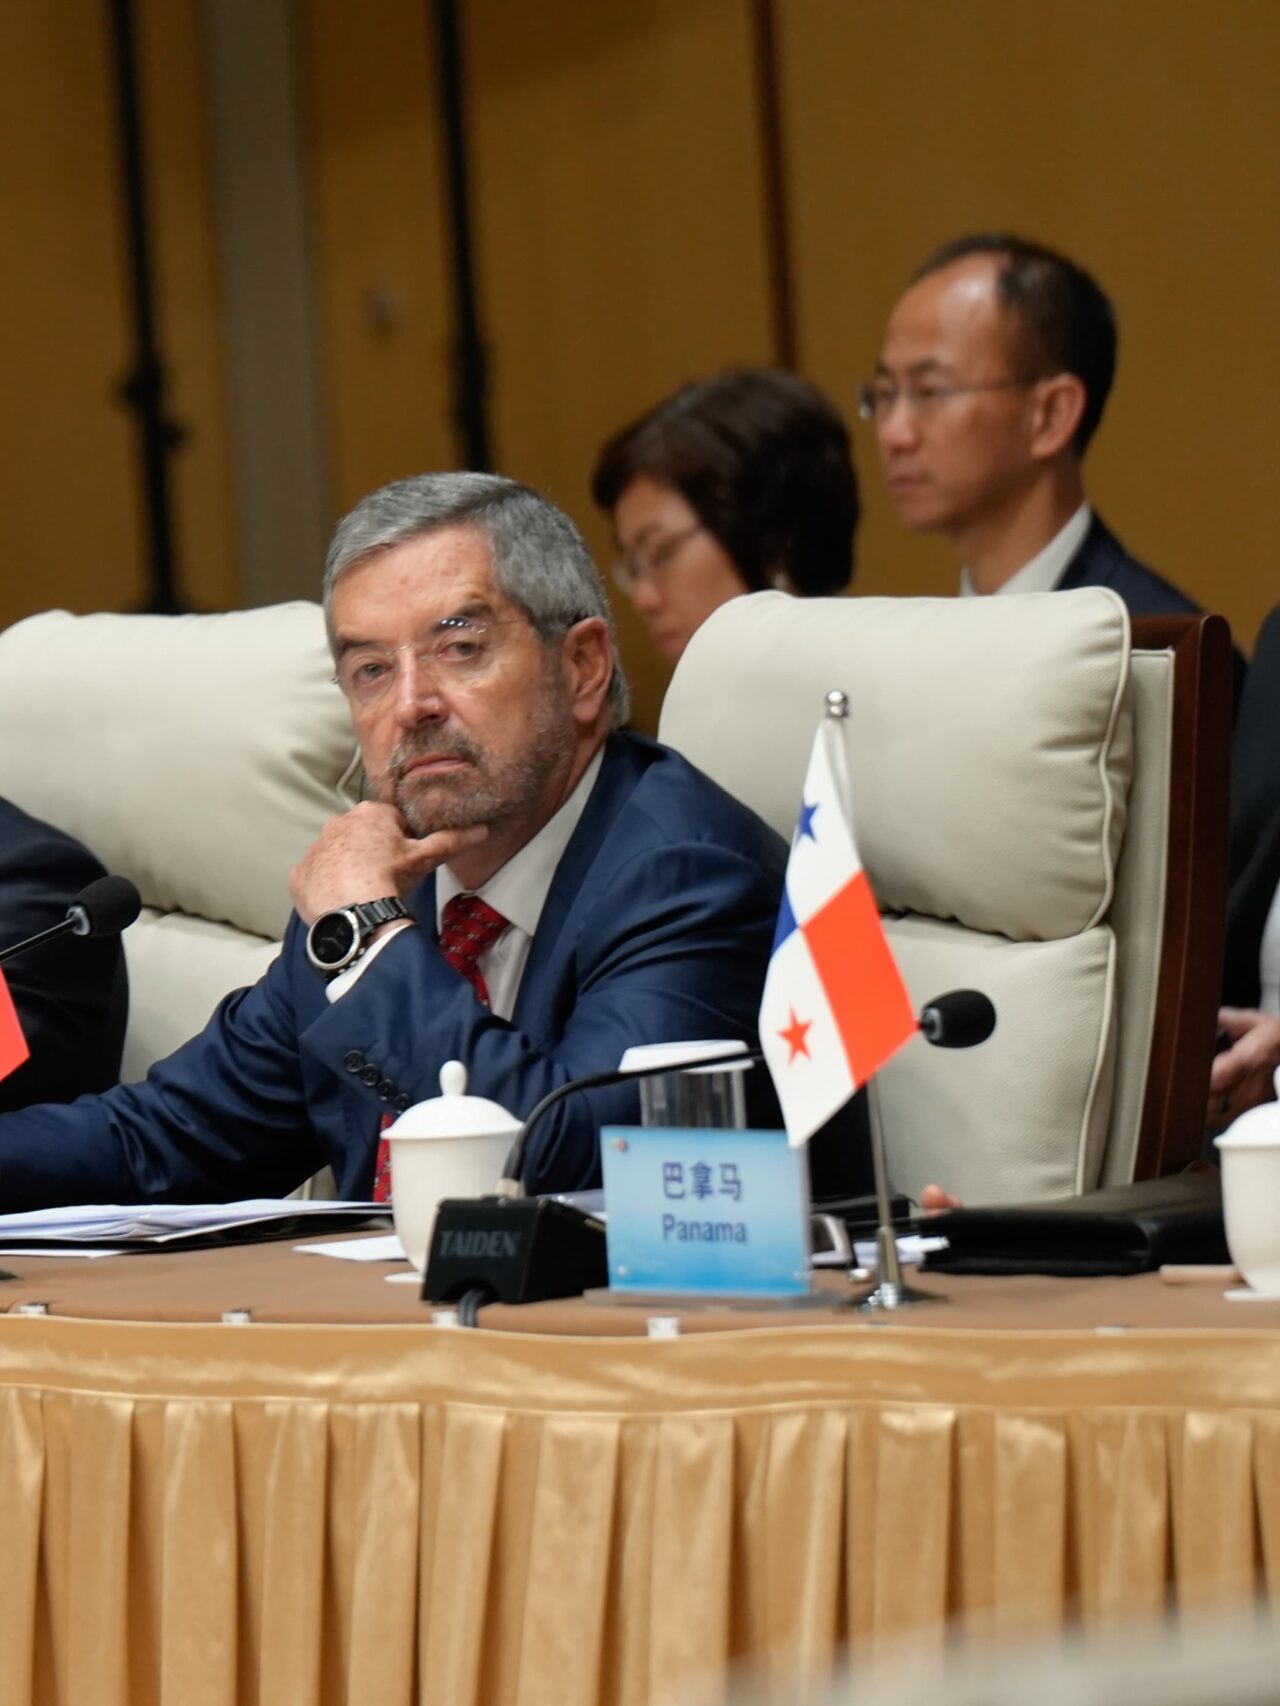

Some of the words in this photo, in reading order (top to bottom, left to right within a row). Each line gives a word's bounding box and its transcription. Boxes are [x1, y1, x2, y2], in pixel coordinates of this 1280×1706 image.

[661, 1161, 742, 1202] 巴拿马
[439, 1229, 519, 1260] TAIDEN
[661, 1213, 748, 1245] Panama
